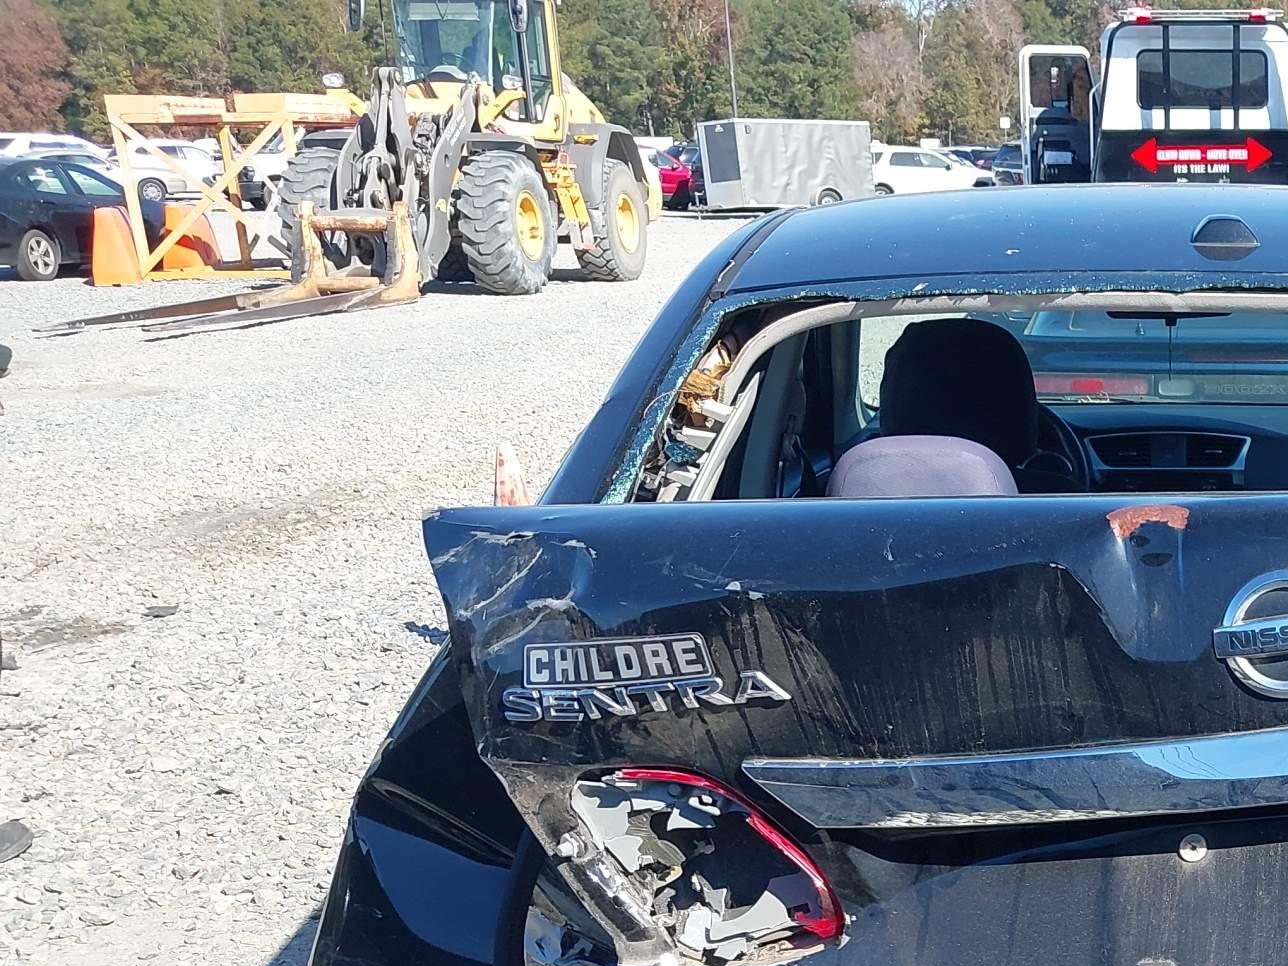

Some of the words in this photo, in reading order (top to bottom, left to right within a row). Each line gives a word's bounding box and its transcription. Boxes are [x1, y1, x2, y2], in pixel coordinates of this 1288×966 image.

[1189, 164, 1206, 173] THE
[529, 640, 704, 683] CHILDRE
[502, 670, 793, 722] SENTRA
